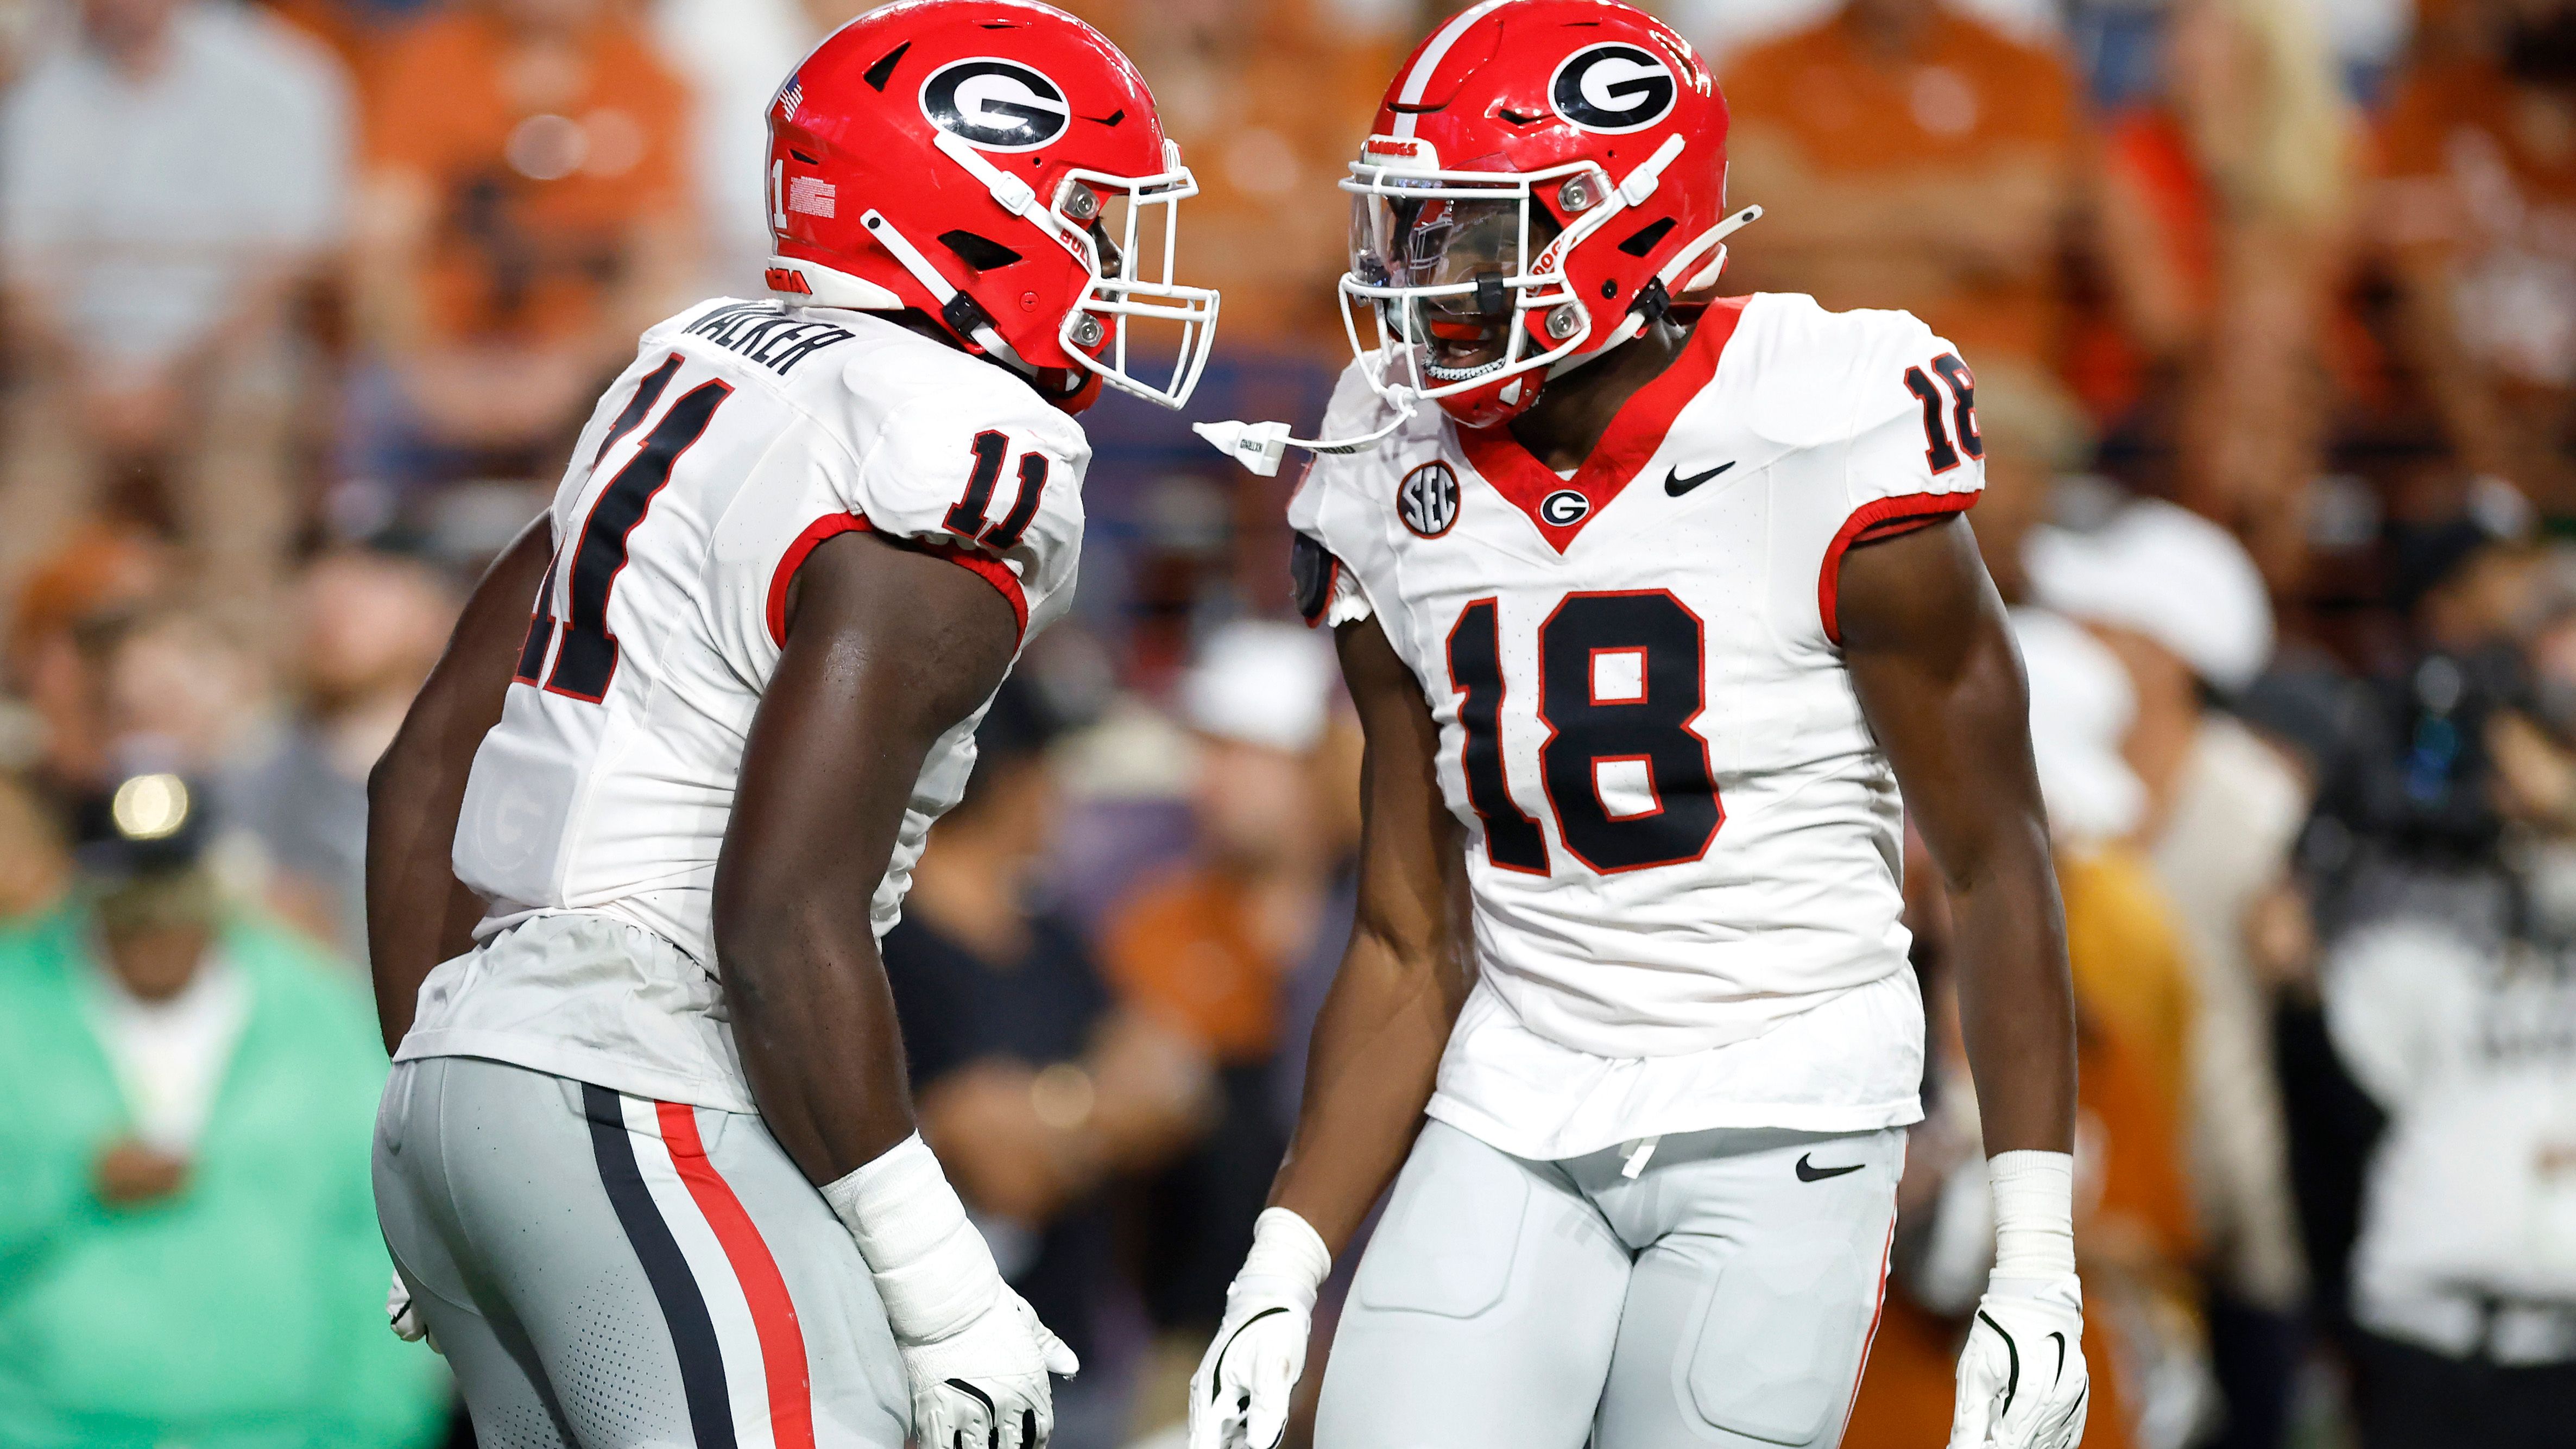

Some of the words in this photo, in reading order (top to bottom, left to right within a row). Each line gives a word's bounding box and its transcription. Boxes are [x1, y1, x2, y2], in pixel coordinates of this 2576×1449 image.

[924, 61, 1065, 146] G
[1555, 47, 1672, 127] G
[681, 301, 856, 376] WALKER
[1903, 351, 1986, 476] 18
[512, 352, 735, 705] 11
[942, 429, 1049, 552] 11
[1400, 465, 1458, 533] SEC
[1542, 492, 1588, 525] G
[1445, 587, 1727, 878] 18
